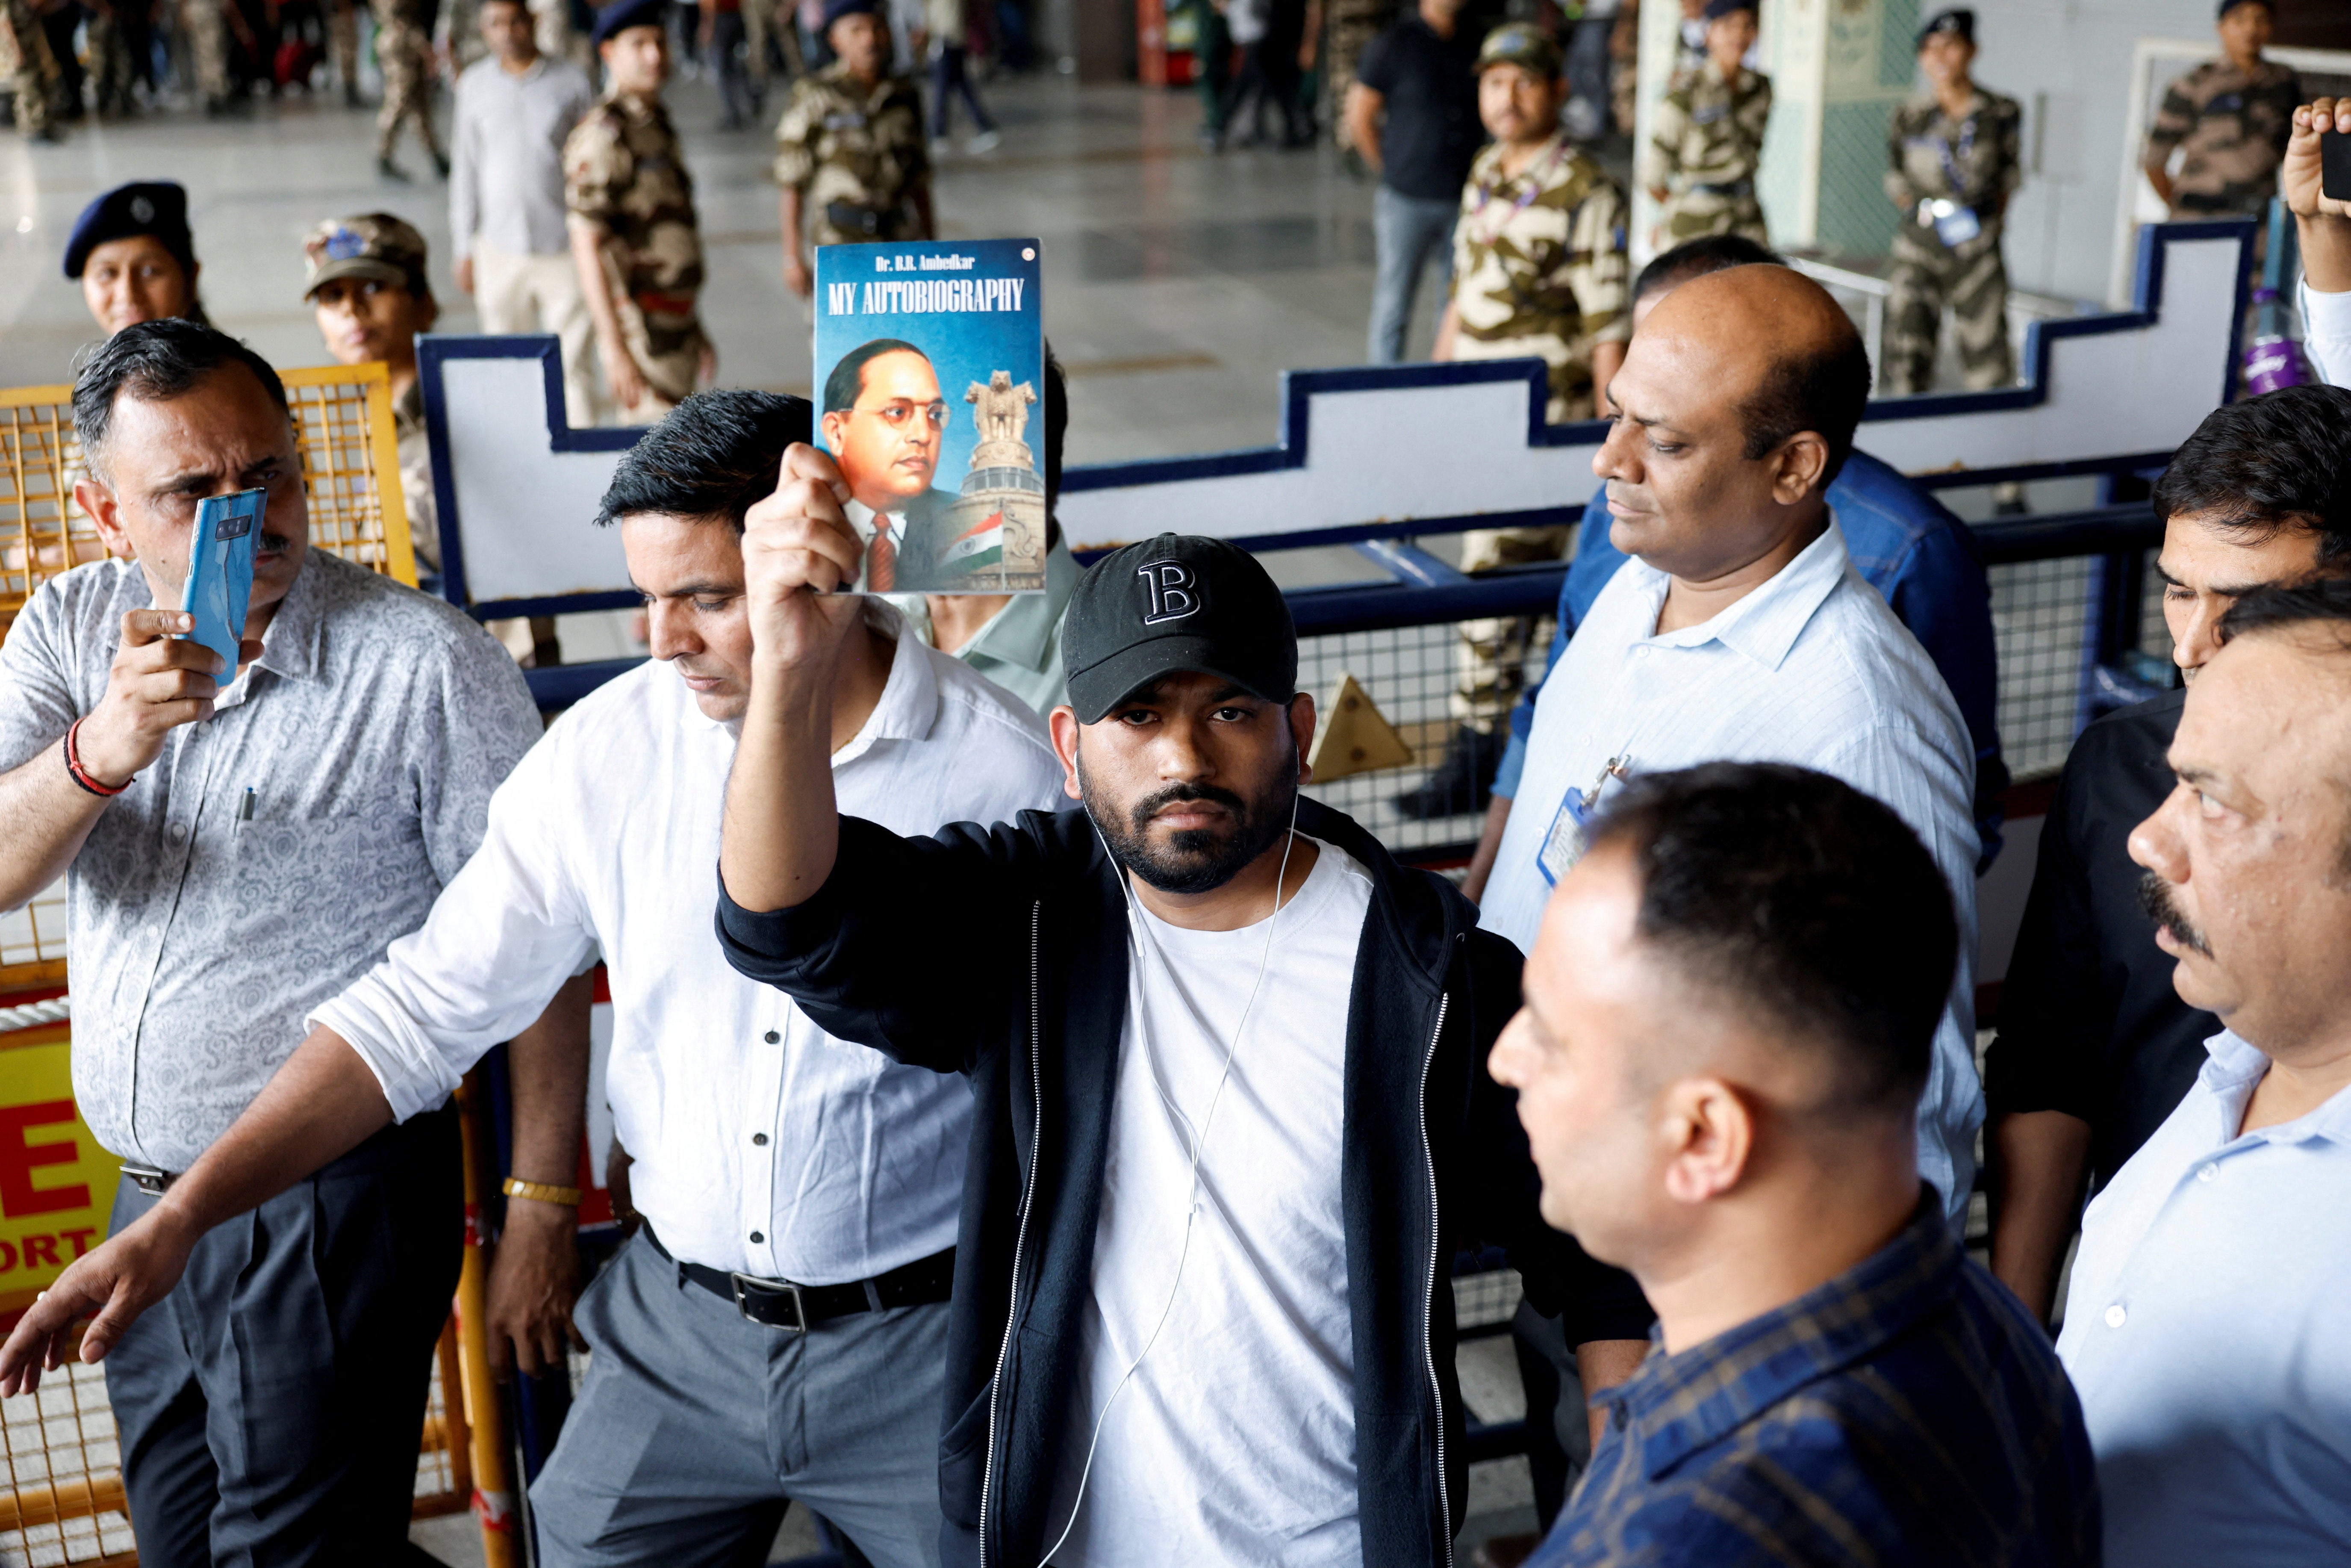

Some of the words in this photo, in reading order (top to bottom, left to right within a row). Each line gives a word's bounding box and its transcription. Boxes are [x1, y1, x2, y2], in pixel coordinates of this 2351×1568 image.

[876, 256, 893, 272] Dr.
[895, 255, 917, 271] B.R.
[919, 253, 975, 271] Ambedkar
[828, 282, 857, 316] MY
[860, 278, 1025, 315] AUTOBIOGRAPHY
[1138, 560, 1201, 625] B
